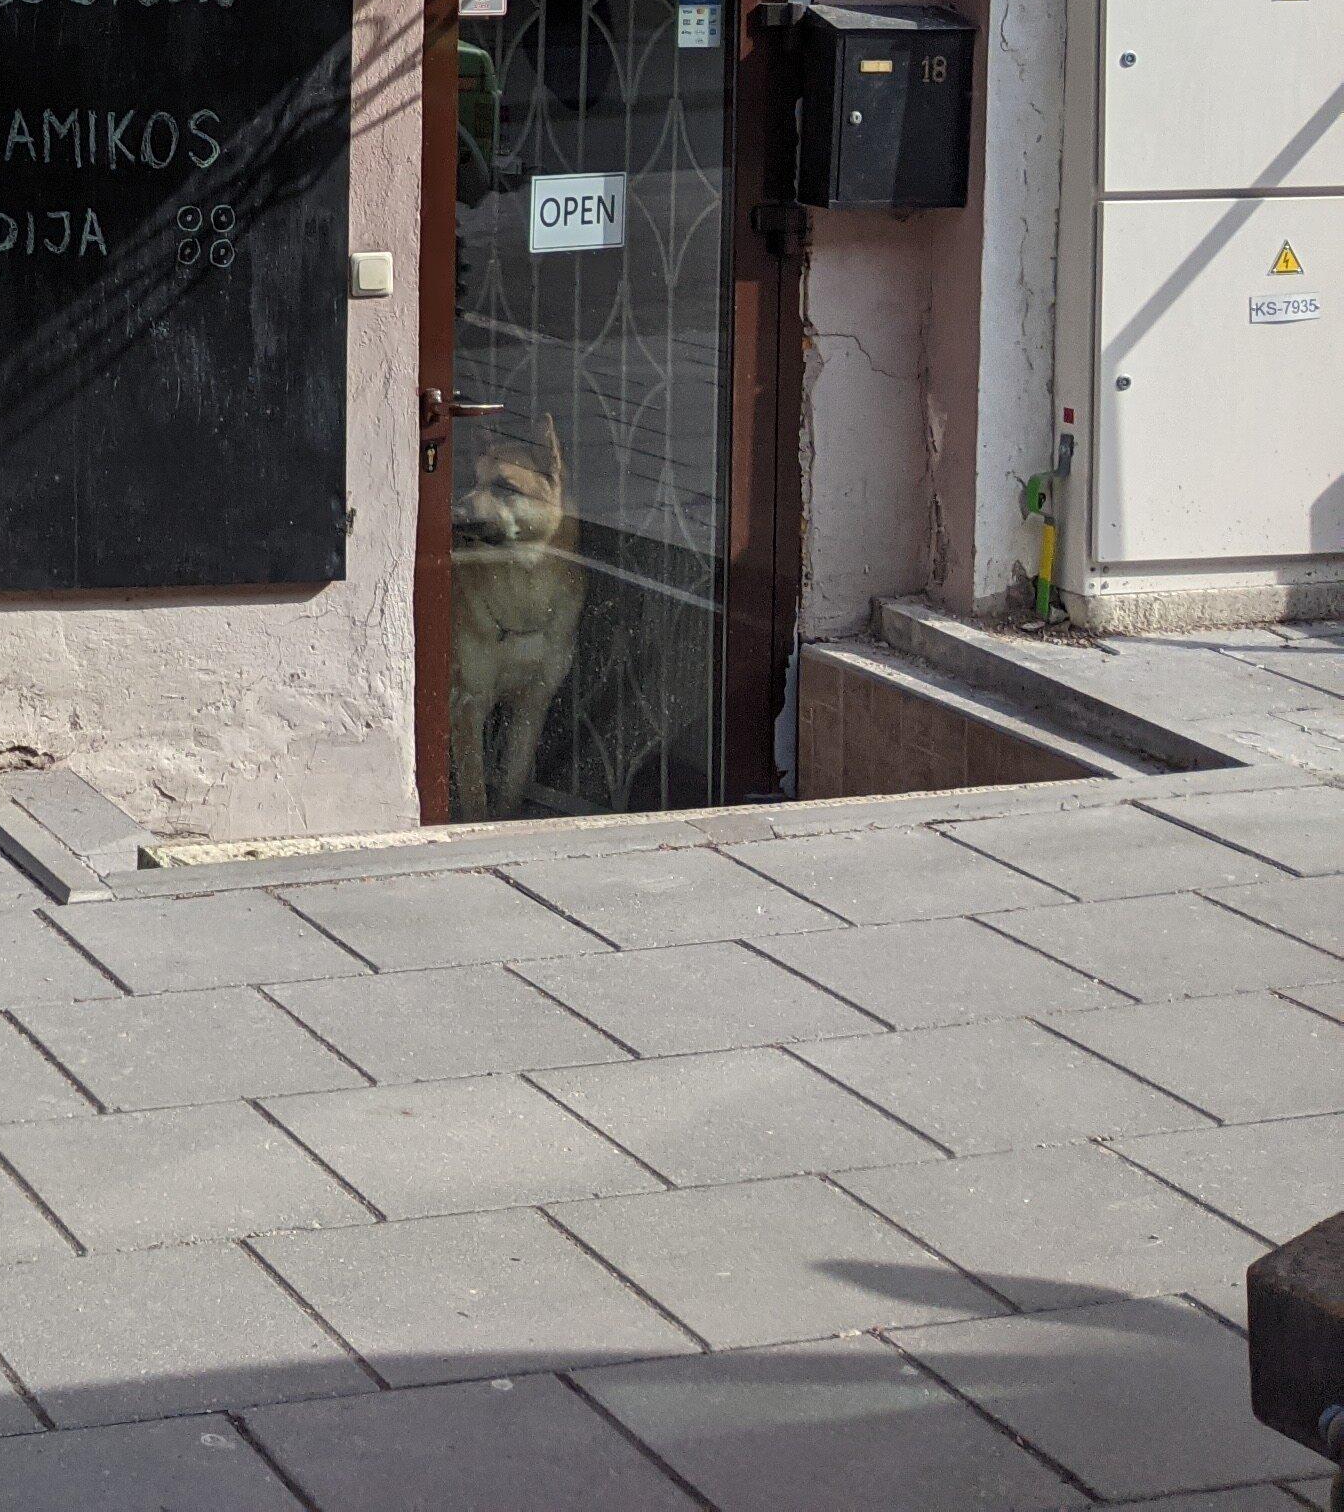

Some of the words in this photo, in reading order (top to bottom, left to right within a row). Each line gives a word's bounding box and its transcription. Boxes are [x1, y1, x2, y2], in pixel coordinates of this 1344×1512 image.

[921, 55, 947, 83] 18
[539, 193, 616, 228] OPEN
[1254, 298, 1318, 317] KS-7935
